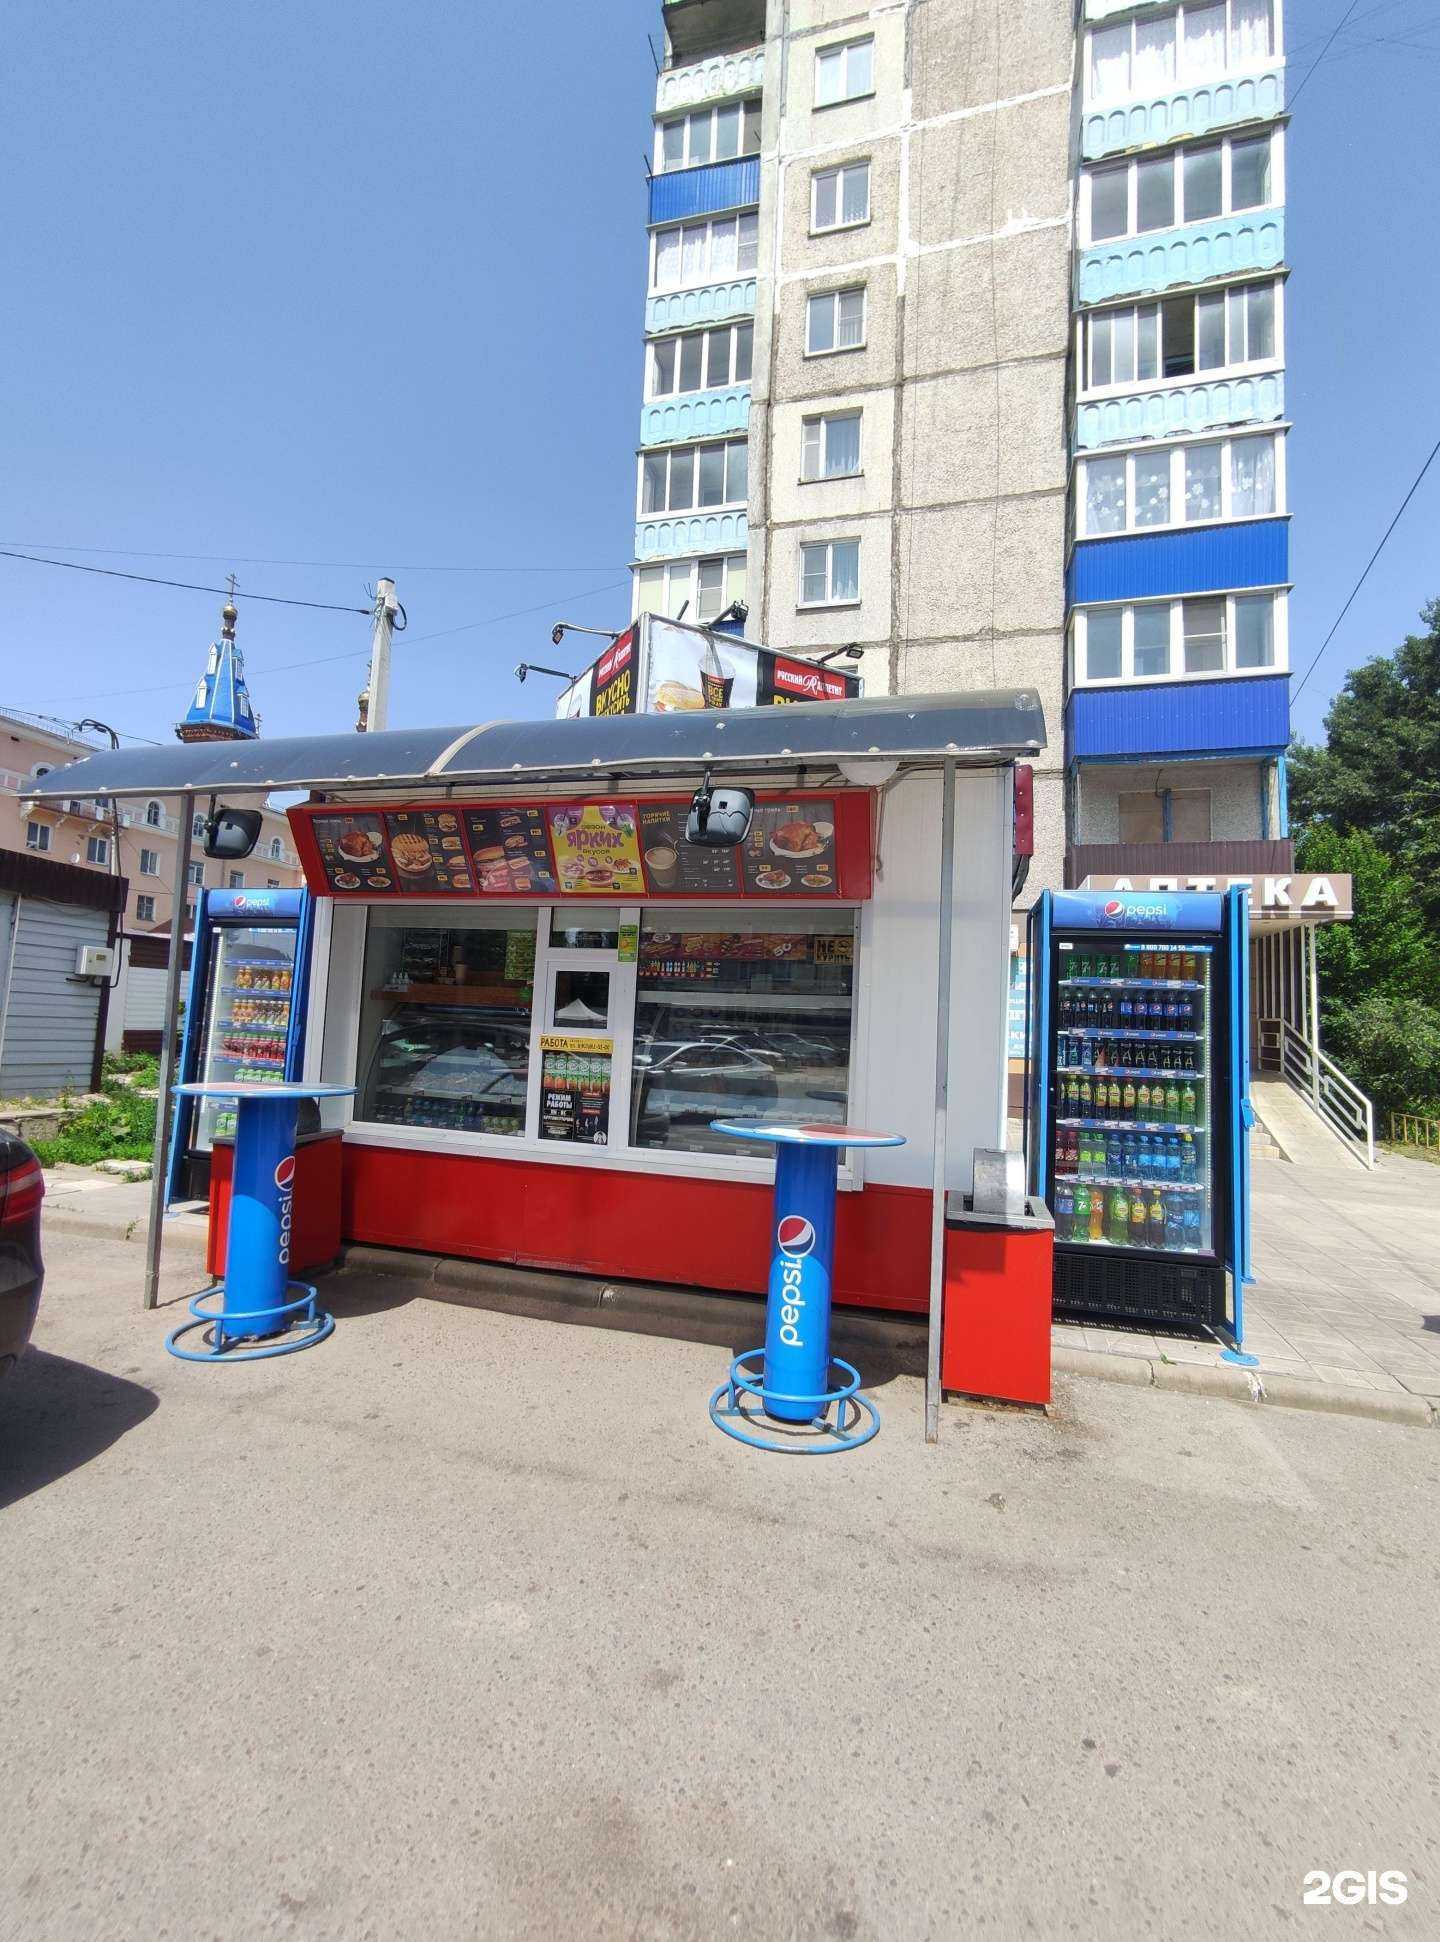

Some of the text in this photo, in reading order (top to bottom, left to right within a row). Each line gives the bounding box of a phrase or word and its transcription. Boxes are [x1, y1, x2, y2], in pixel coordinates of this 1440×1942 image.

[777, 670, 803, 686] РУССКИЙ
[595, 669, 631, 715] ВКУСНО
[642, 816, 671, 825] НАПИТКИ
[566, 829, 625, 850] ЯРКИХ
[246, 896, 270, 911] pepsi
[1127, 903, 1168, 919] pepsi
[540, 1037, 568, 1048] РАБОТА
[546, 1100, 572, 1109] РАБОТЫ
[547, 1093, 571, 1101] РЕЖИМ
[279, 1195, 296, 1264] pepsi
[779, 1259, 805, 1347] pepsi
